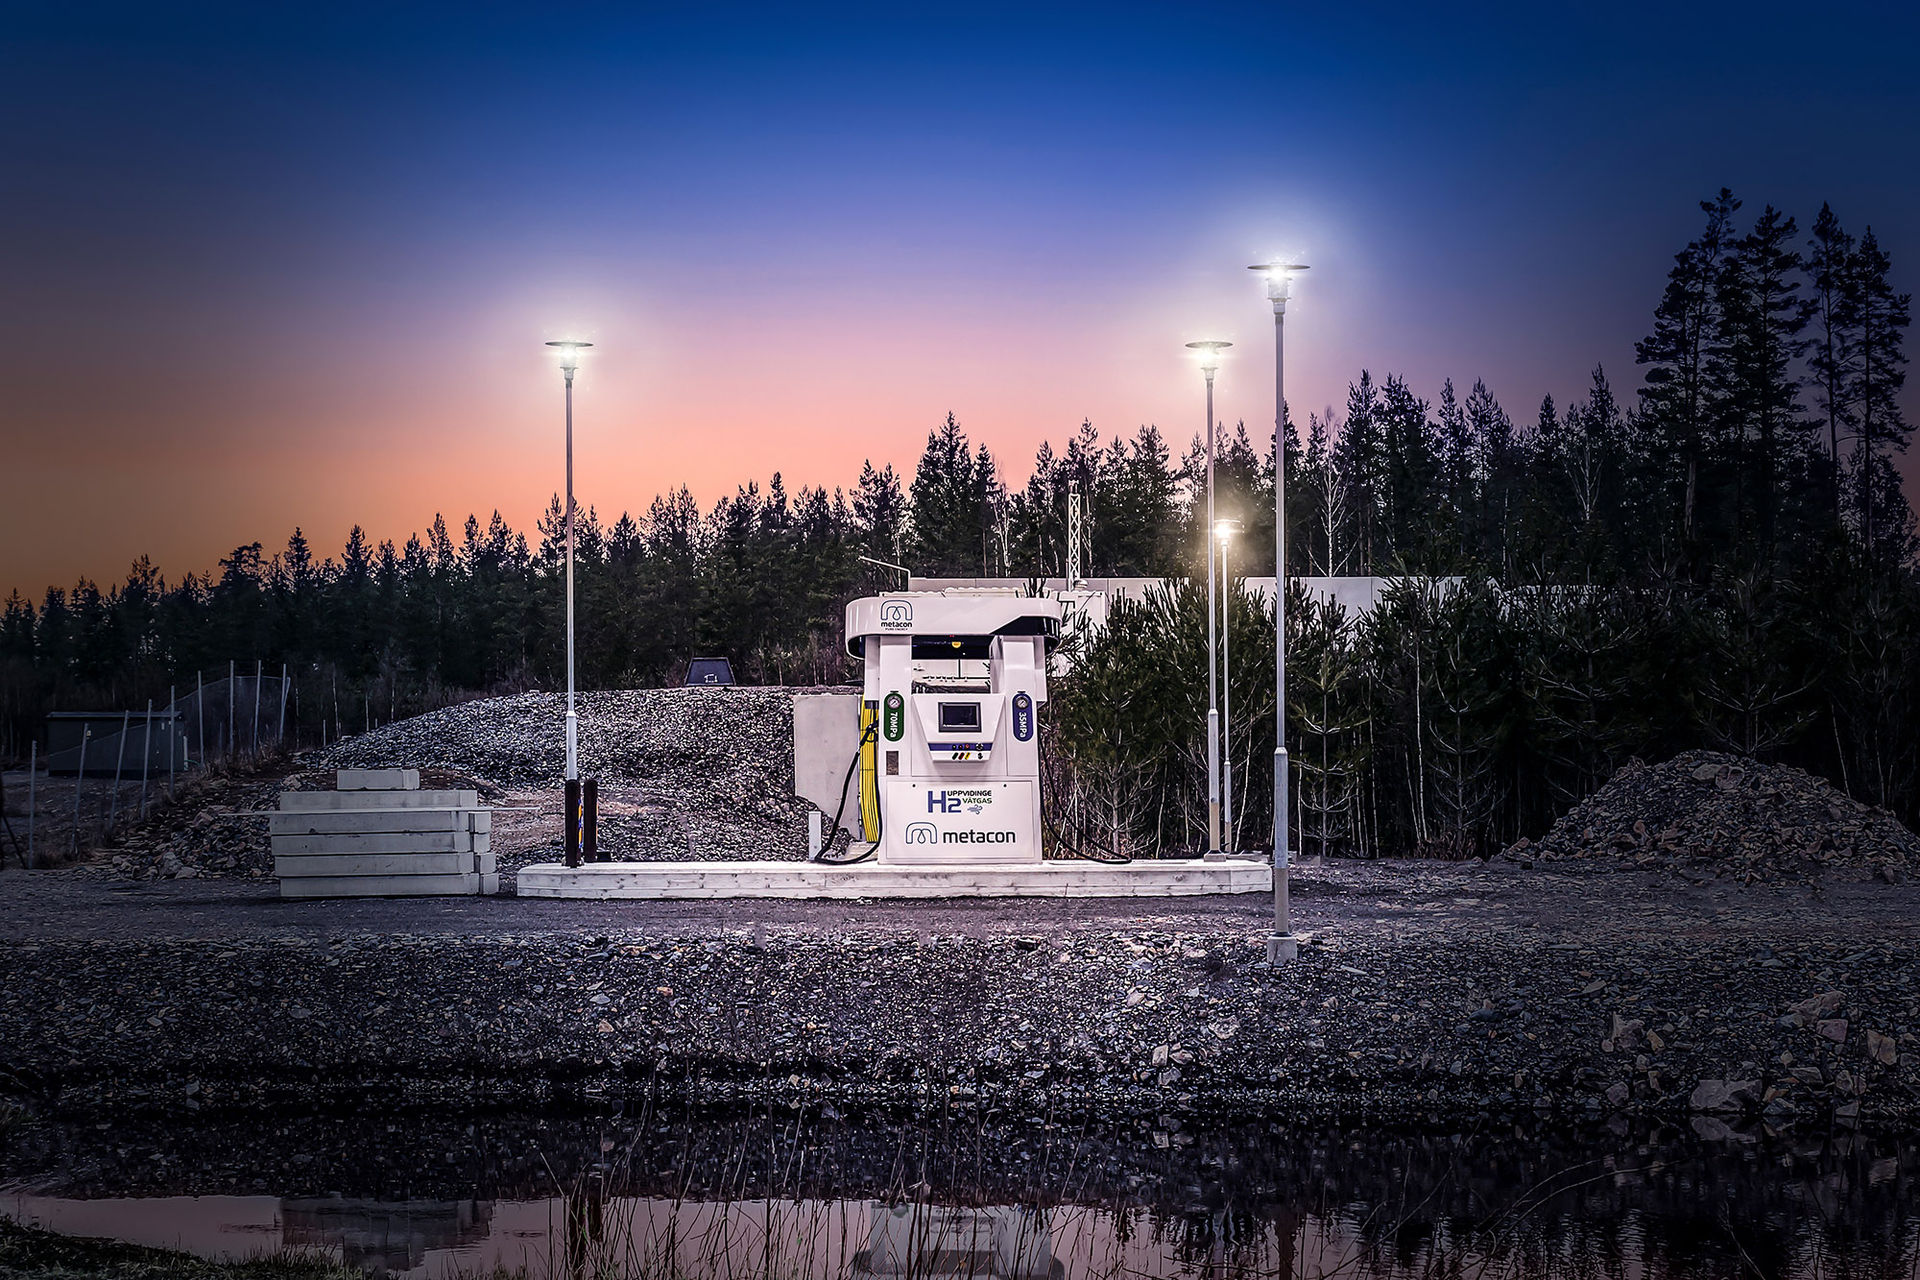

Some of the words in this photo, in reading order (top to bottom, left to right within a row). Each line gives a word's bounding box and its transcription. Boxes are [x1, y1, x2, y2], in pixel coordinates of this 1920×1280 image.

[890, 711, 898, 738] 70MPa
[1018, 711, 1028, 738] 35MPa
[928, 790, 962, 813] H2
[962, 796, 993, 804] VÅTGAS
[943, 829, 1016, 843] metacon
